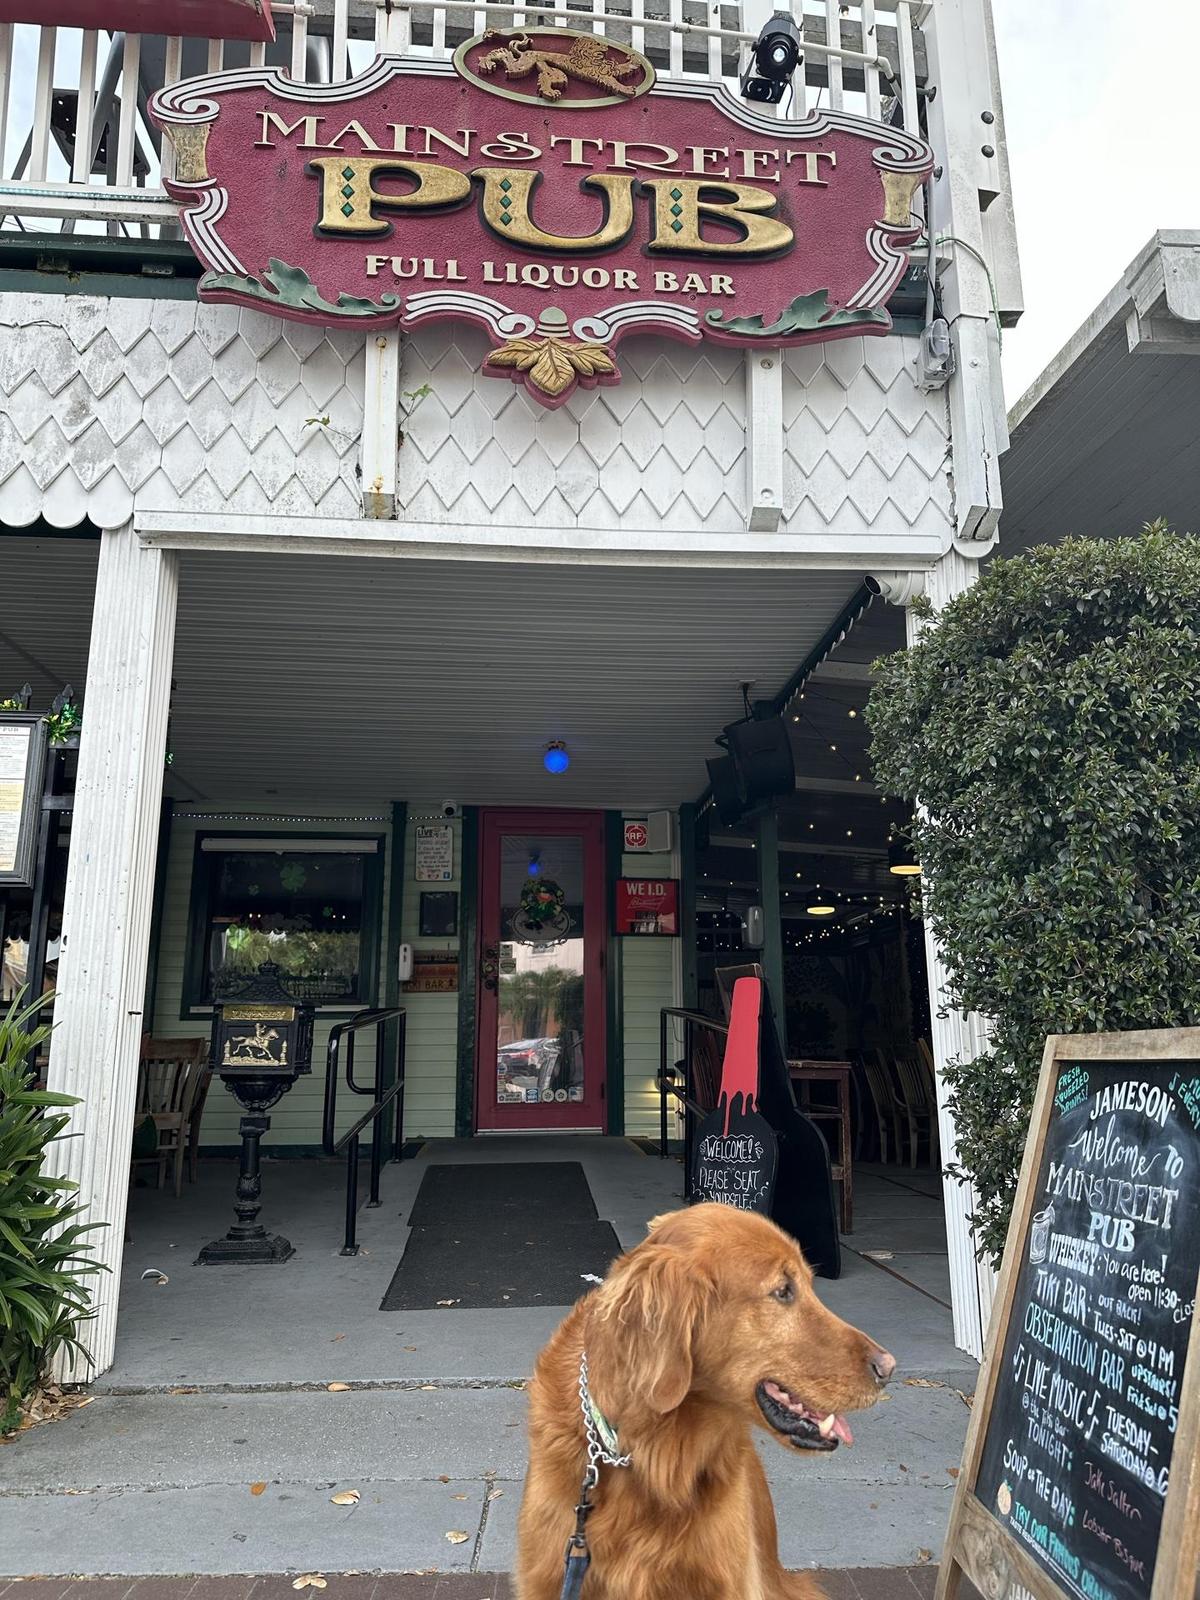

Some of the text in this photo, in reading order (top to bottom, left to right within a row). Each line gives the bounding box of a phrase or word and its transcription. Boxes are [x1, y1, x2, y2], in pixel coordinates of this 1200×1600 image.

[307, 157, 795, 254] PUB
[365, 255, 736, 295] FULL LIQUOR BAR
[626, 883, 667, 896] WE I.D.
[1054, 1072, 1090, 1106] SQUEEZED
[1058, 1066, 1081, 1090] FRESH
[705, 1138, 753, 1160] WELCOME!
[1068, 1114, 1161, 1178] Welcome
[699, 1166, 761, 1193] PLEASE SEAT
[1045, 1161, 1179, 1229] MAINSTREET
[1087, 1211, 1136, 1252] PUB
[1103, 1253, 1120, 1276] You
[1121, 1263, 1139, 1282] are
[1140, 1254, 1168, 1285] here!
[1098, 1294, 1115, 1312] OUT
[1024, 1302, 1125, 1394] OBSERVATION BAR
[1024, 1353, 1087, 1430] LIVE MUSIC
[1035, 1468, 1052, 1502] THE
[1015, 1501, 1031, 1531] TRY
[1030, 1518, 1049, 1549] OUR
